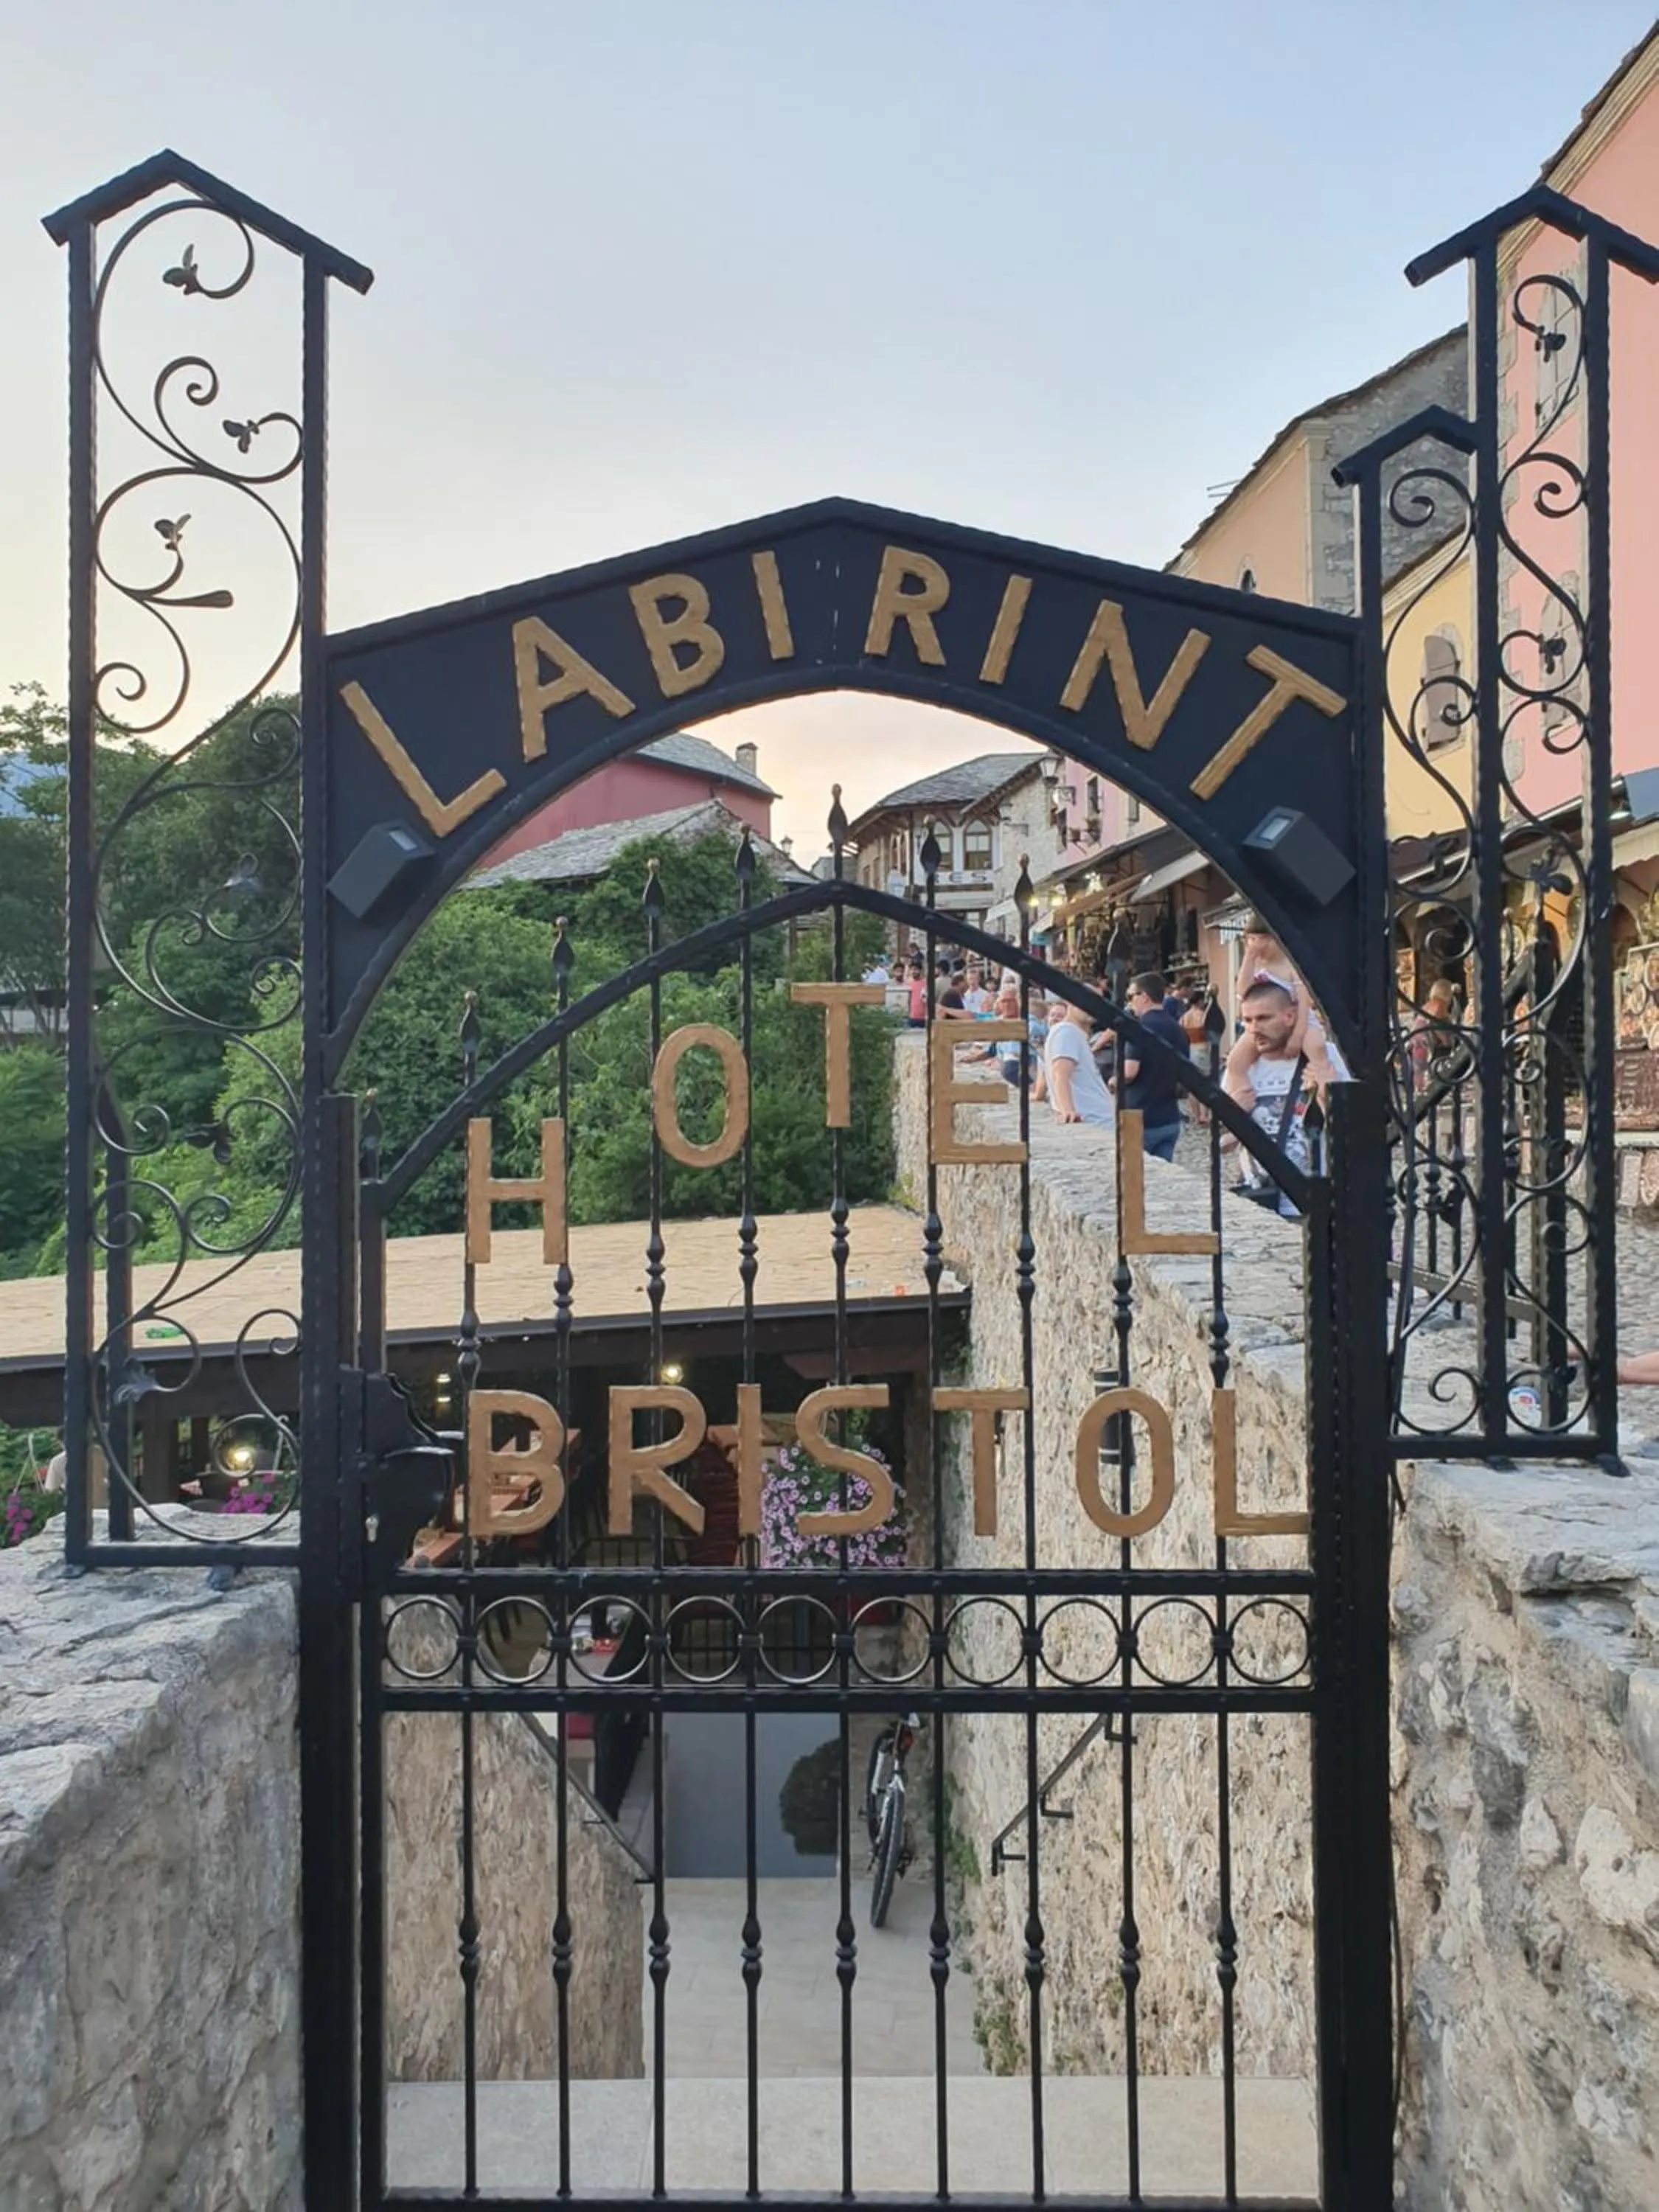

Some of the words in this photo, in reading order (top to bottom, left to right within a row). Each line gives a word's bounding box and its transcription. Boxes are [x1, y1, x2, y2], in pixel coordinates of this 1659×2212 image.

[340, 547, 1347, 838] LABIRINT
[466, 983, 1218, 1267] HOTEL
[467, 1384, 1309, 1538] BRISTOL
